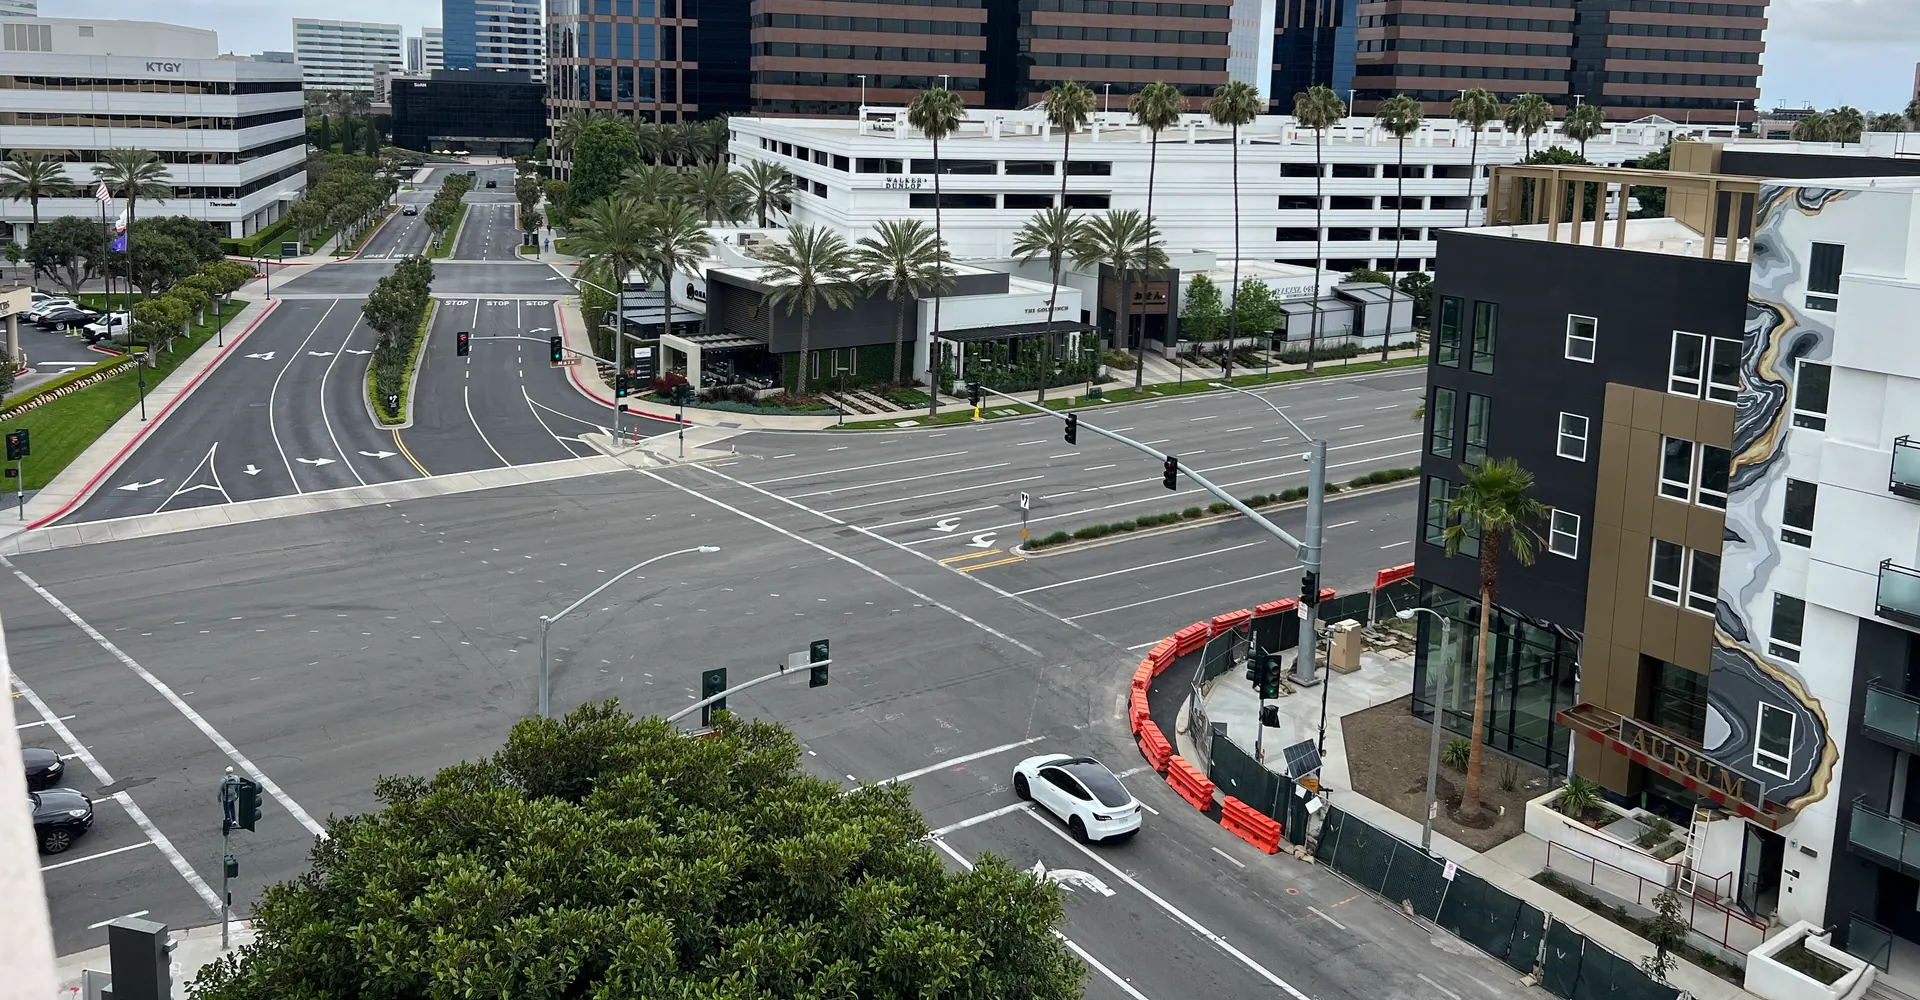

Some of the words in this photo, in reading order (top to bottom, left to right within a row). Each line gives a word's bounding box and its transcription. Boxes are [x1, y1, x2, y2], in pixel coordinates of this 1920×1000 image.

[146, 61, 182, 72] KTGY
[885, 182, 922, 190] DUNLOP
[1631, 728, 1746, 803] AURUM
